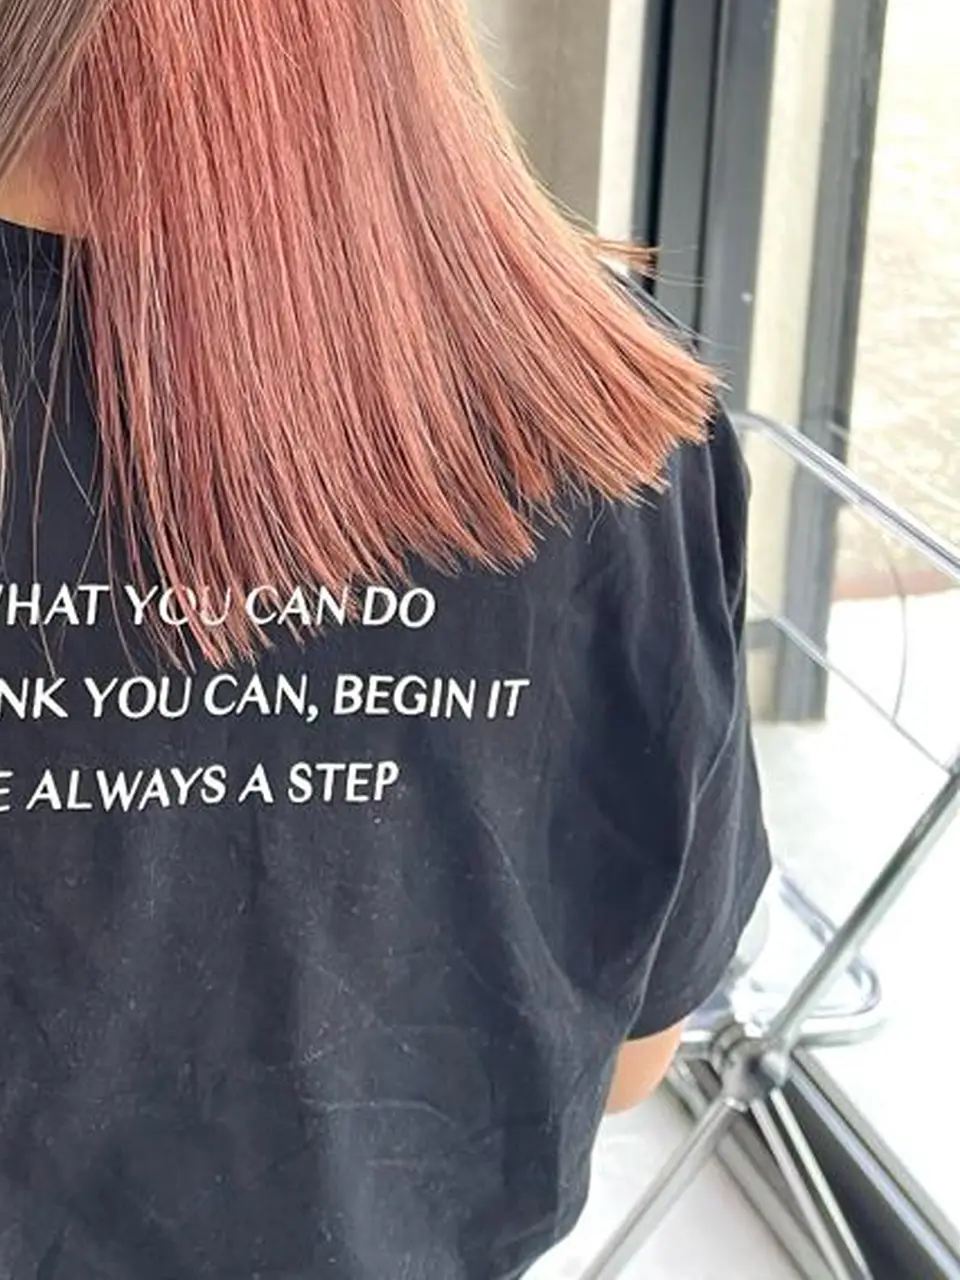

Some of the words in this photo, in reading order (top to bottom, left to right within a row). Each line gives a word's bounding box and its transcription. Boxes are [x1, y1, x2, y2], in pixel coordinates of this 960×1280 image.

[124, 584, 232, 627] YOU
[245, 584, 349, 626] CAN
[362, 585, 436, 629] DO
[83, 676, 192, 719] YOU
[203, 673, 319, 723] CAN,
[333, 673, 476, 719] BEGIN
[487, 678, 531, 720] IT
[25, 765, 227, 812] ALWAYS
[239, 763, 275, 804] A
[287, 761, 400, 804] STEP
